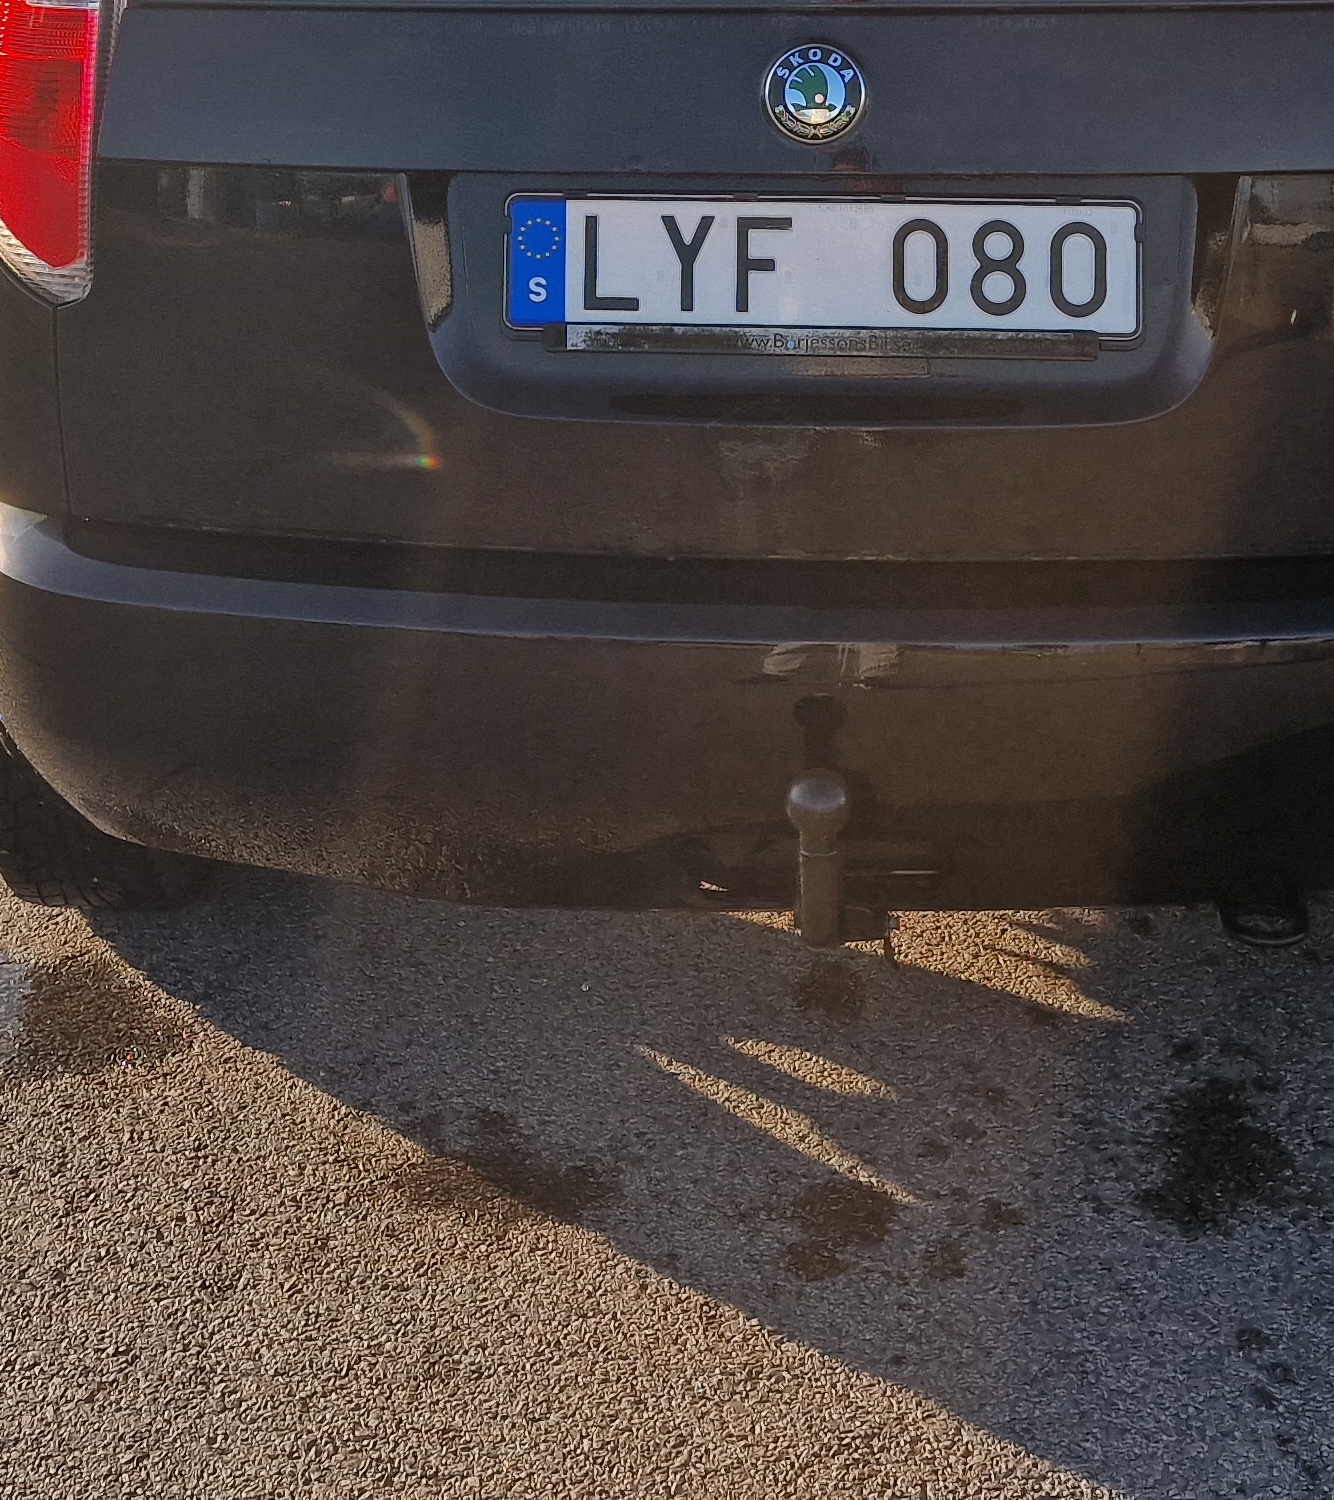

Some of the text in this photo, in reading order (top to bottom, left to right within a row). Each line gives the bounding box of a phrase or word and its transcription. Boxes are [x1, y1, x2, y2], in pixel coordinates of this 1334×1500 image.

[528, 276, 548, 303] S
[584, 215, 1107, 318] LYF 080
